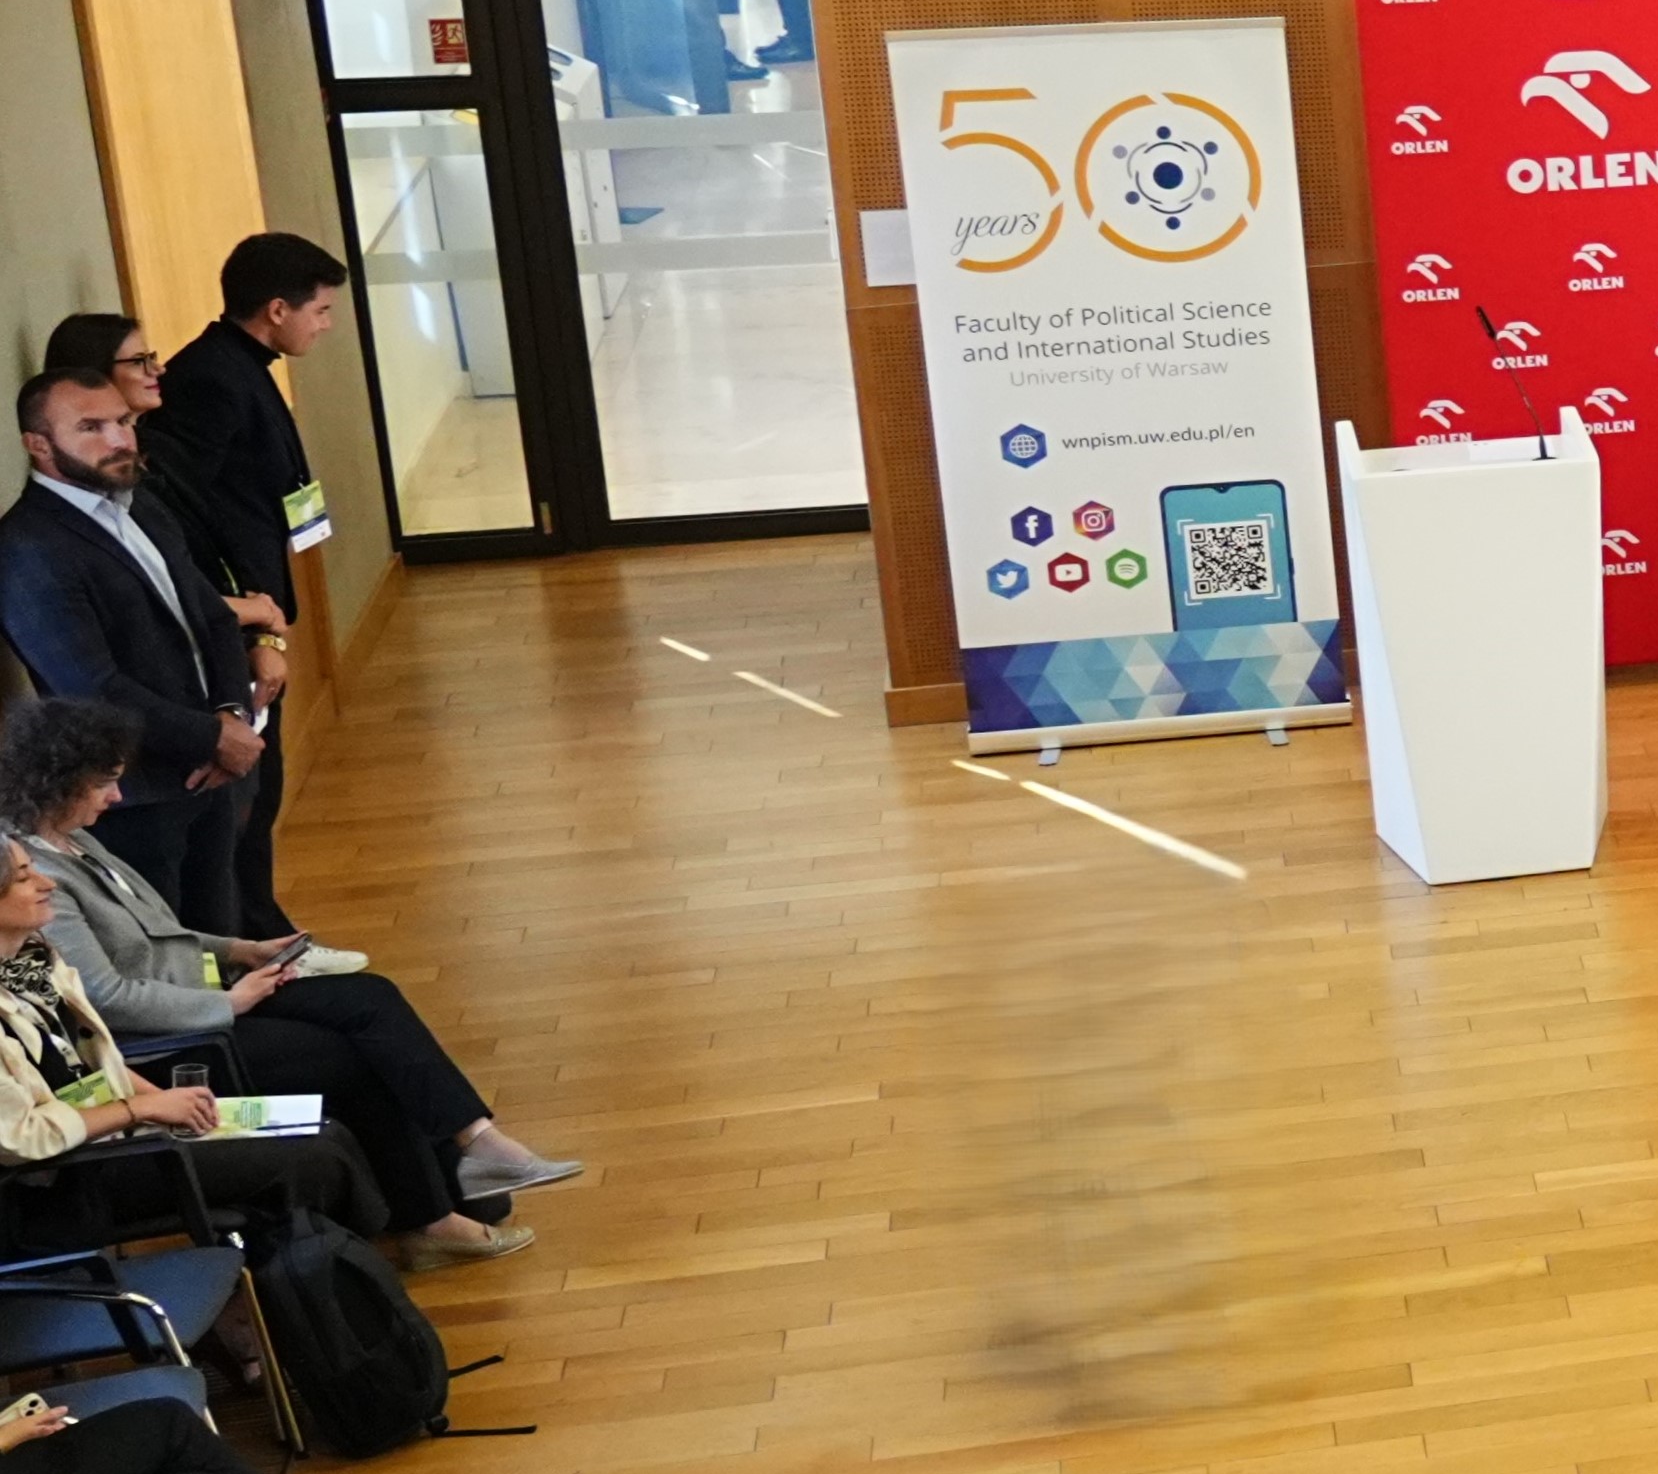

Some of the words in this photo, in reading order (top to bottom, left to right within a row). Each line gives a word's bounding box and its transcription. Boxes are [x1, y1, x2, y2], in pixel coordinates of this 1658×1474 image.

[1390, 139, 1449, 155] ORLEN
[950, 211, 1041, 256] years
[1568, 275, 1625, 292] ORLEN
[1402, 287, 1460, 303] ORLEN
[954, 312, 1041, 336] Faculty
[1050, 308, 1073, 329] of
[1081, 302, 1175, 326] Political
[1182, 300, 1272, 321] Science
[963, 341, 1009, 362] and
[1018, 331, 1175, 359] International
[1183, 327, 1271, 350] Studies
[1491, 354, 1549, 370] ORLEN
[1009, 364, 1114, 388] University
[1120, 362, 1141, 380] of
[1146, 359, 1230, 378] Warsaw
[1061, 424, 1255, 450] wnpism.uw.edu.pl/en
[1584, 419, 1636, 435] ORLEN
